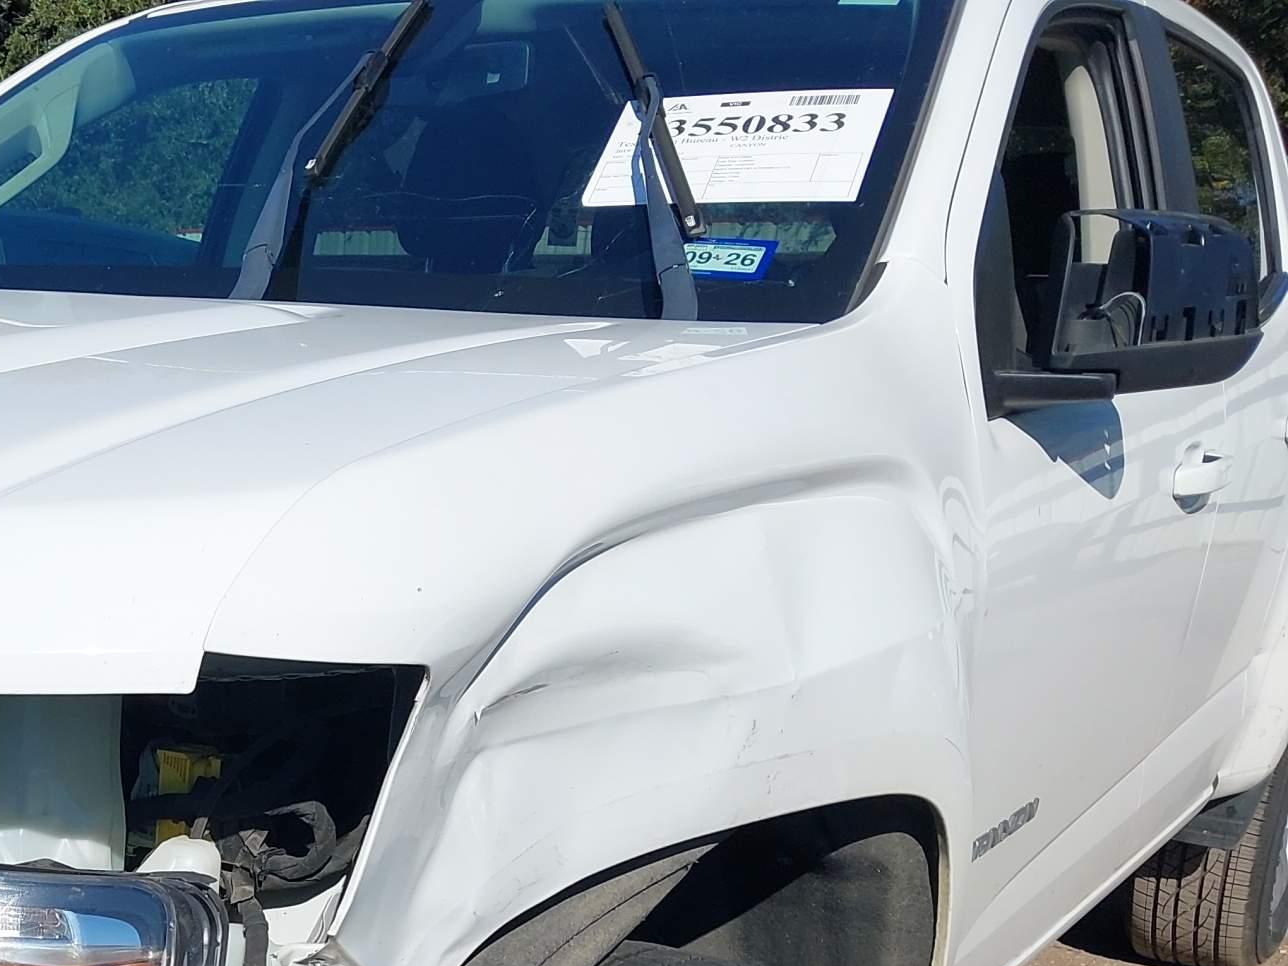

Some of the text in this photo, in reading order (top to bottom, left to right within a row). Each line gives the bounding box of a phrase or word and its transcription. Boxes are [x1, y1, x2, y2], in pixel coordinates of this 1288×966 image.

[669, 112, 847, 137] 3550833
[686, 250, 758, 267] 09 26
